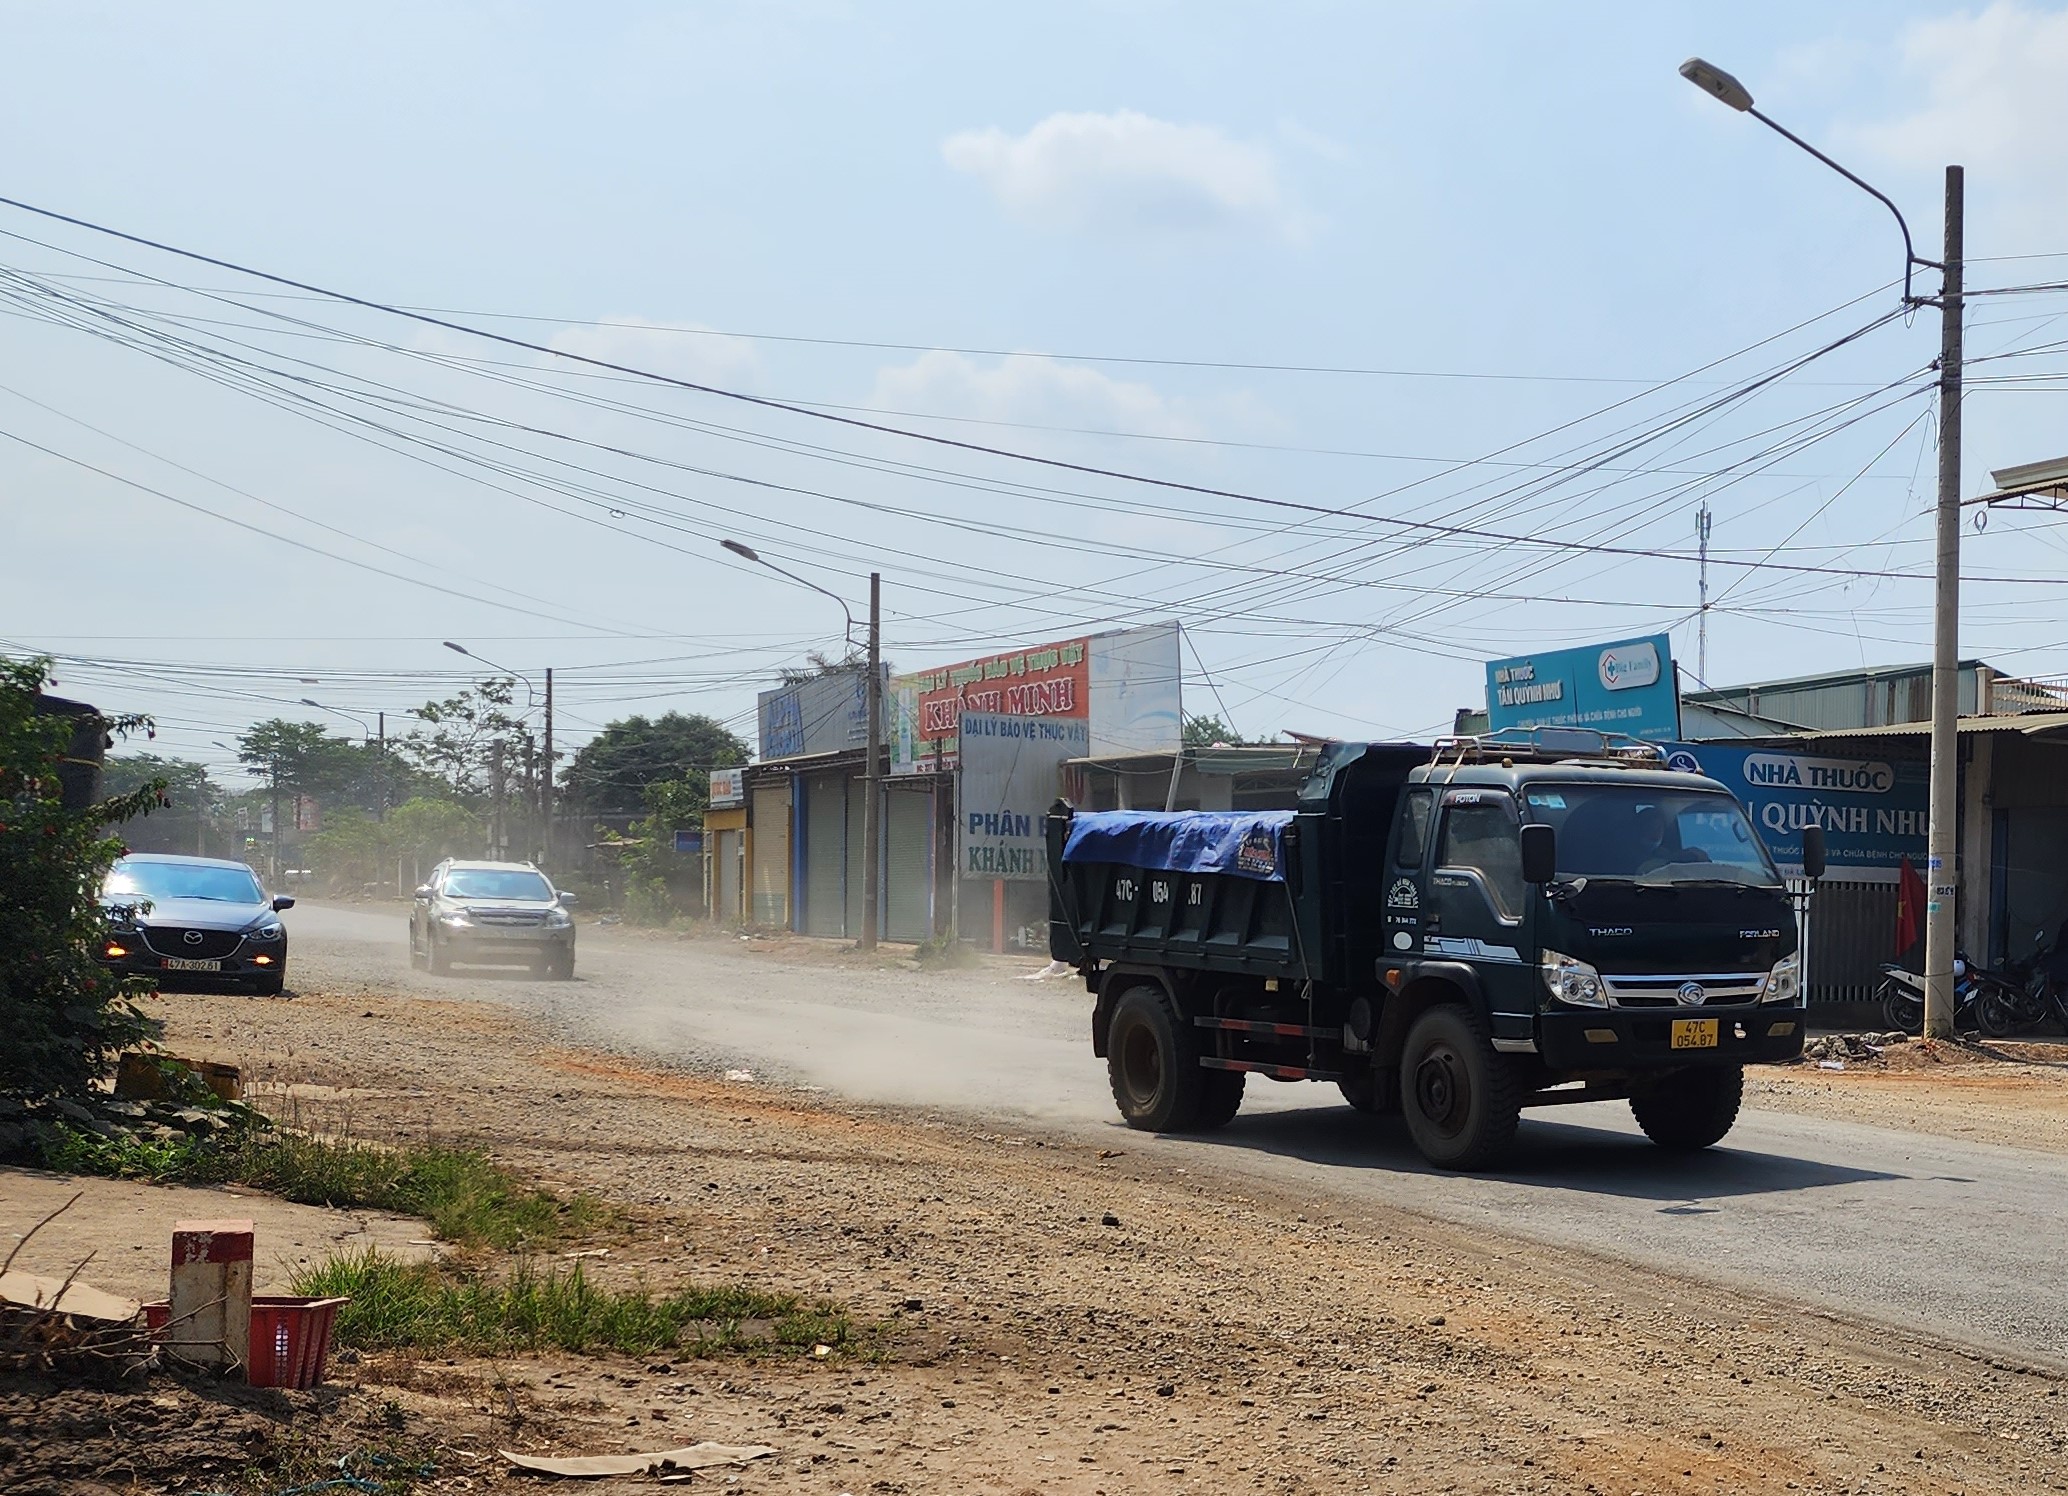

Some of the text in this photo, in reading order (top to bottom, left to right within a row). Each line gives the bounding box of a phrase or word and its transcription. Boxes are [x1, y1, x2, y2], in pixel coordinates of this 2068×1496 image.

[1008, 677, 1074, 715] MINH
[965, 718, 982, 738] ĐẠI
[985, 716, 998, 736] LÝ
[1001, 718, 1021, 737] BẢO
[1023, 720, 1036, 741] VỆ
[1750, 759, 1887, 790] NHÀ THUỐC
[1454, 793, 1481, 804] FOTON
[969, 809, 1030, 837] PHÂN
[1762, 798, 1868, 835] QUỲNH
[968, 840, 1033, 874] KHÁNH
[1152, 880, 1169, 903] 054
[1589, 928, 1633, 937] THACO
[1739, 929, 1780, 938] FORLAND
[1685, 1021, 1706, 1034] 47C
[1677, 1034, 1714, 1047] 054.87
